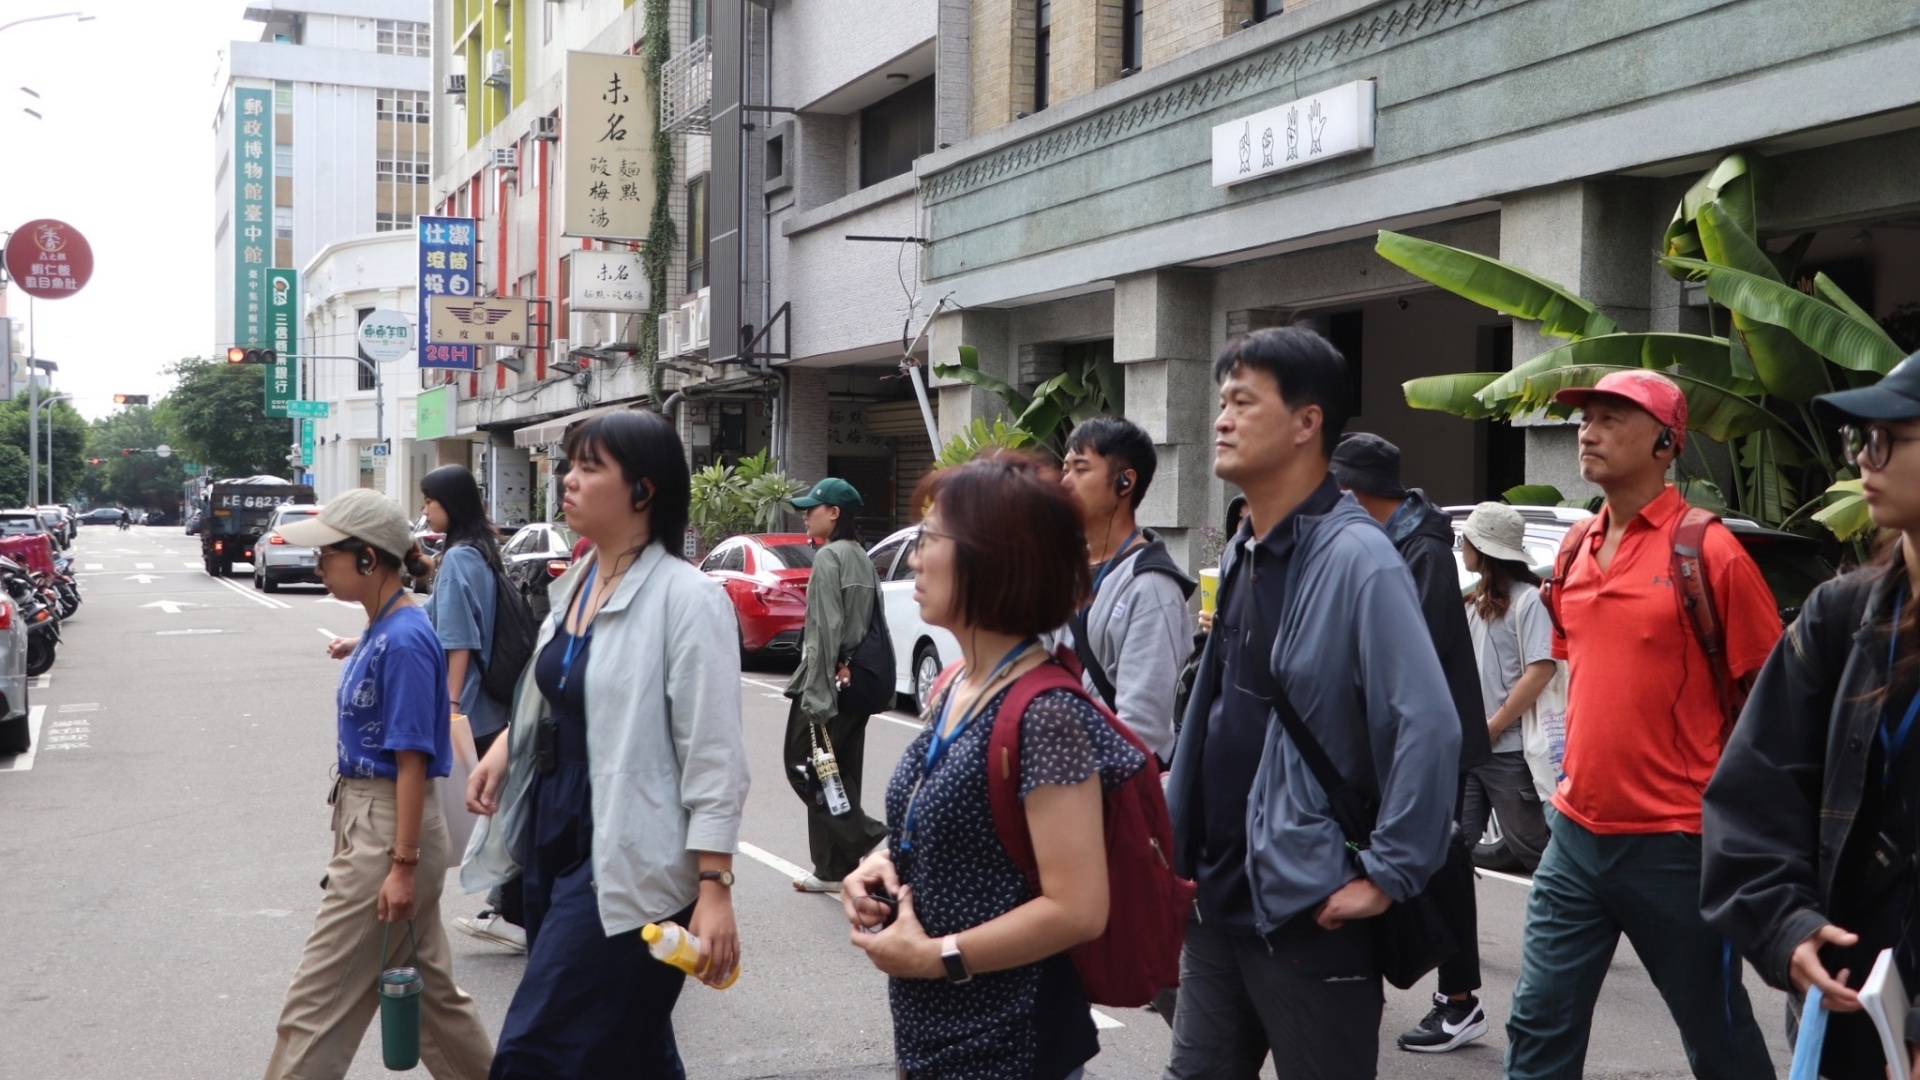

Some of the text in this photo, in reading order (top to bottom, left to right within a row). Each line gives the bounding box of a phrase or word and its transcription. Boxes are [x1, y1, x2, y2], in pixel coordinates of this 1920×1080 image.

[596, 72, 629, 143] 未名
[243, 98, 263, 264] 郵政博物館臺中館
[619, 158, 641, 202] 麵點
[597, 263, 629, 281] 未名
[248, 269, 259, 347] 臺中集郵服務中
[275, 313, 288, 394] 三信商業銀行
[425, 345, 468, 362] 24H
